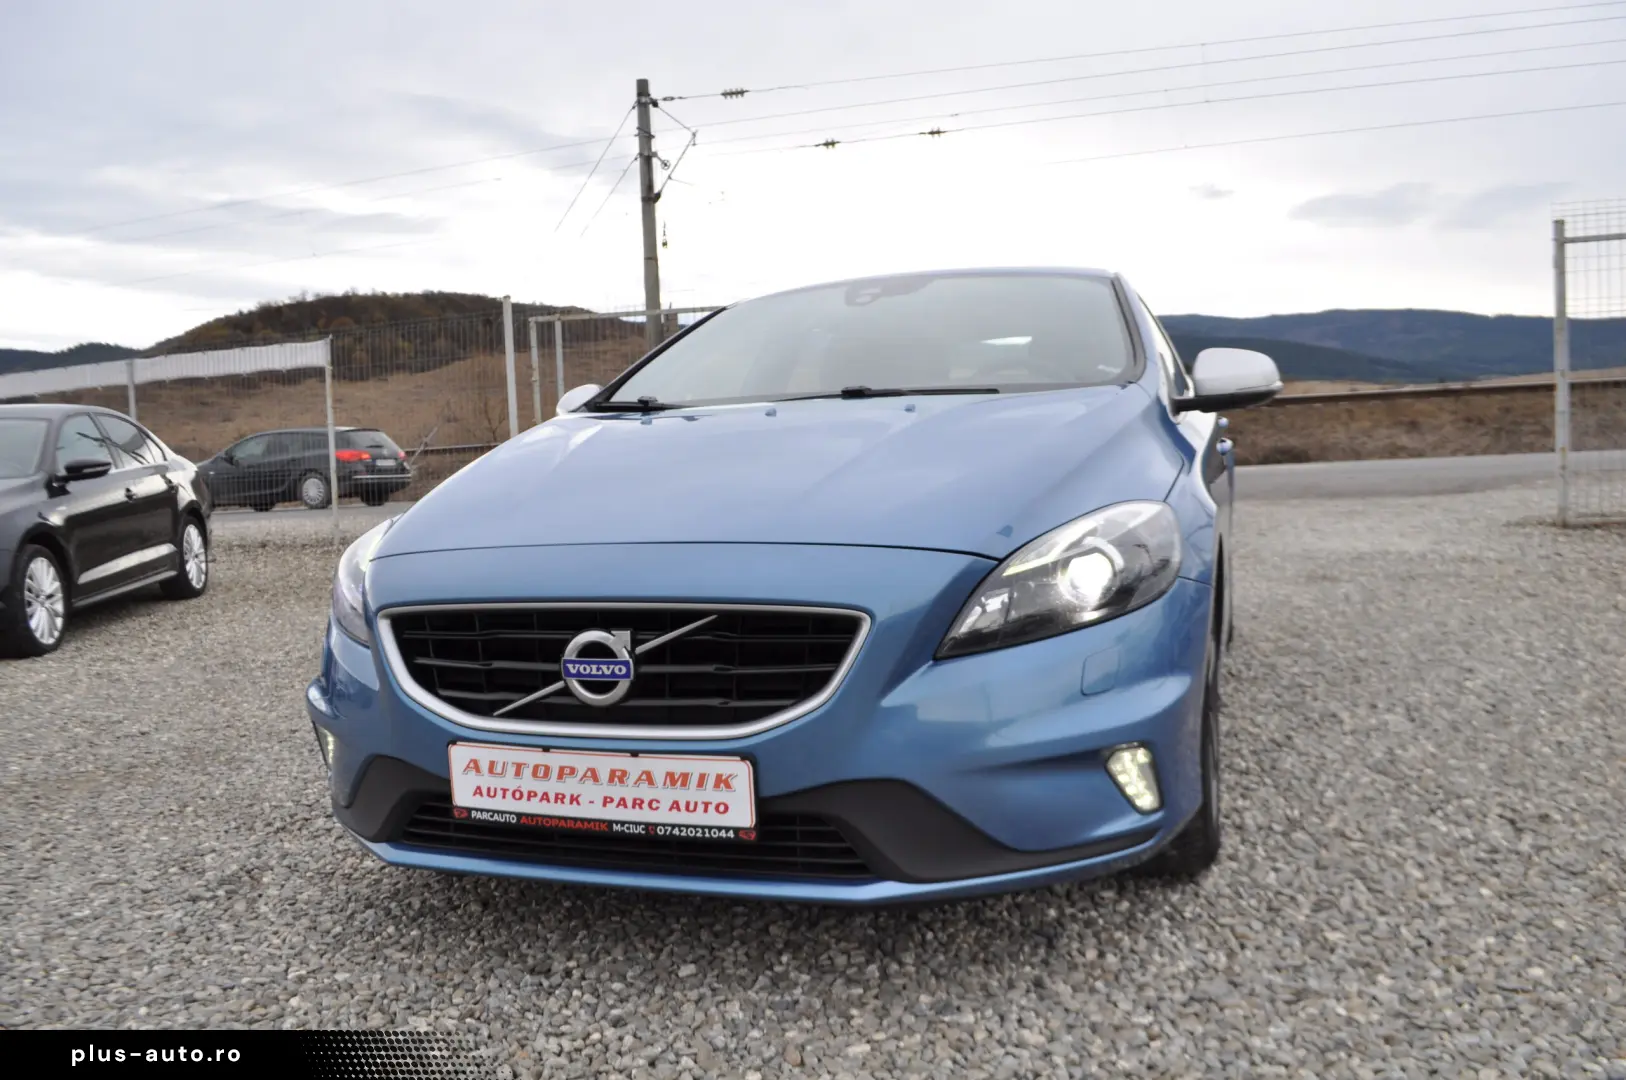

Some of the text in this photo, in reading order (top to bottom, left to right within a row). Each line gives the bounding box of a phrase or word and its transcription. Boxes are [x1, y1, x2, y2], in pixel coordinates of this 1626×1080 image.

[566, 663, 627, 675] VOLVO
[462, 758, 738, 792] AUTOPARAMIK
[472, 784, 582, 806] AUTÓPARK
[601, 795, 661, 812] PARC
[668, 799, 730, 815] AUTO
[471, 809, 735, 839] PARCAUTO AUTOPARAMIK M-CIUC 0742021044
